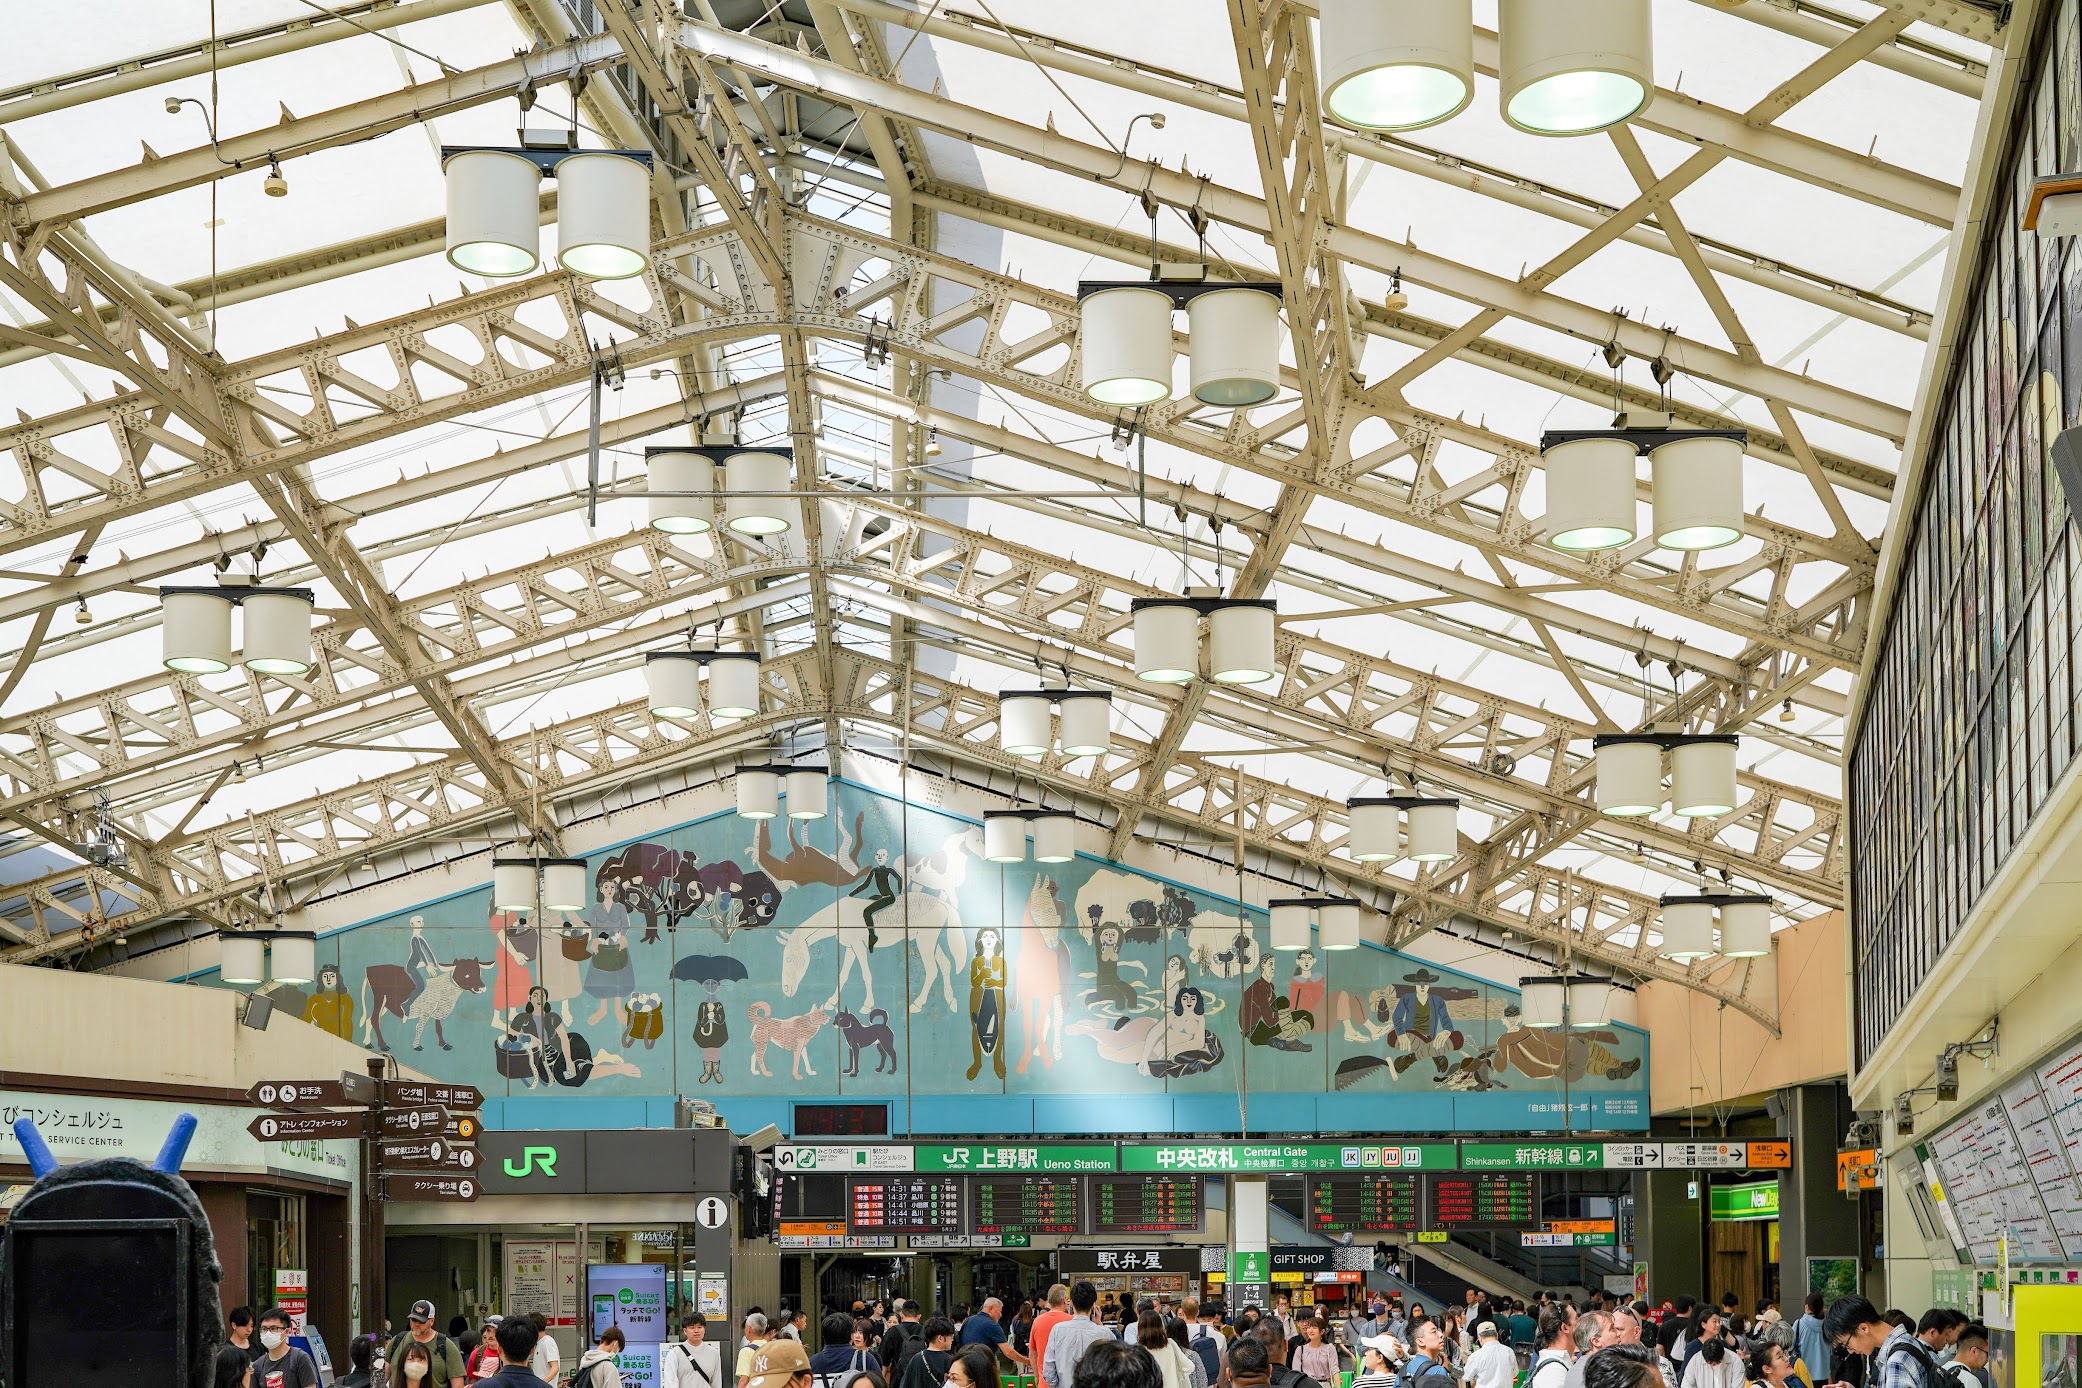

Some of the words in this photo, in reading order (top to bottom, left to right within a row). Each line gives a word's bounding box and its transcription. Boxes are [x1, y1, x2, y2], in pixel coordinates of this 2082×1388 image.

[299, 1086, 323, 1095] お手洗
[397, 1087, 423, 1097] パンダ橋
[435, 1090, 449, 1098] 交番
[279, 1120, 297, 1129] アトレ
[299, 1119, 348, 1128] インフォメーション
[48, 1135, 86, 1145] SERVICE
[89, 1137, 123, 1147] CENTER
[942, 1148, 970, 1163] JR
[1243, 1147, 1281, 1157] Central
[1283, 1147, 1308, 1157] Gate
[1345, 1153, 1356, 1161] JK
[1366, 1153, 1377, 1161] JY
[1386, 1153, 1397, 1161] JU
[1407, 1153, 1416, 1161] JJ
[1515, 1148, 1564, 1165] 新幹線
[503, 1146, 558, 1178] JR
[976, 1147, 1038, 1169] 上野駅
[1156, 1147, 1239, 1168] 中央改札
[1465, 1157, 1511, 1166] Shinkansen
[1043, 1159, 1071, 1169] Ueno
[1074, 1159, 1111, 1169] Station
[1291, 1159, 1308, 1168] 중앙
[1310, 1159, 1336, 1168] 개찰구
[414, 1181, 457, 1191] タクシー乗り場
[1751, 1189, 1779, 1208] NewDay
[1097, 1251, 1163, 1270] 駅弁屋
[1274, 1254, 1296, 1264] GIFT
[1298, 1254, 1325, 1264] SHOP
[620, 1306, 661, 1315] タッチでGo!
[623, 1361, 652, 1369] 乗るなら
